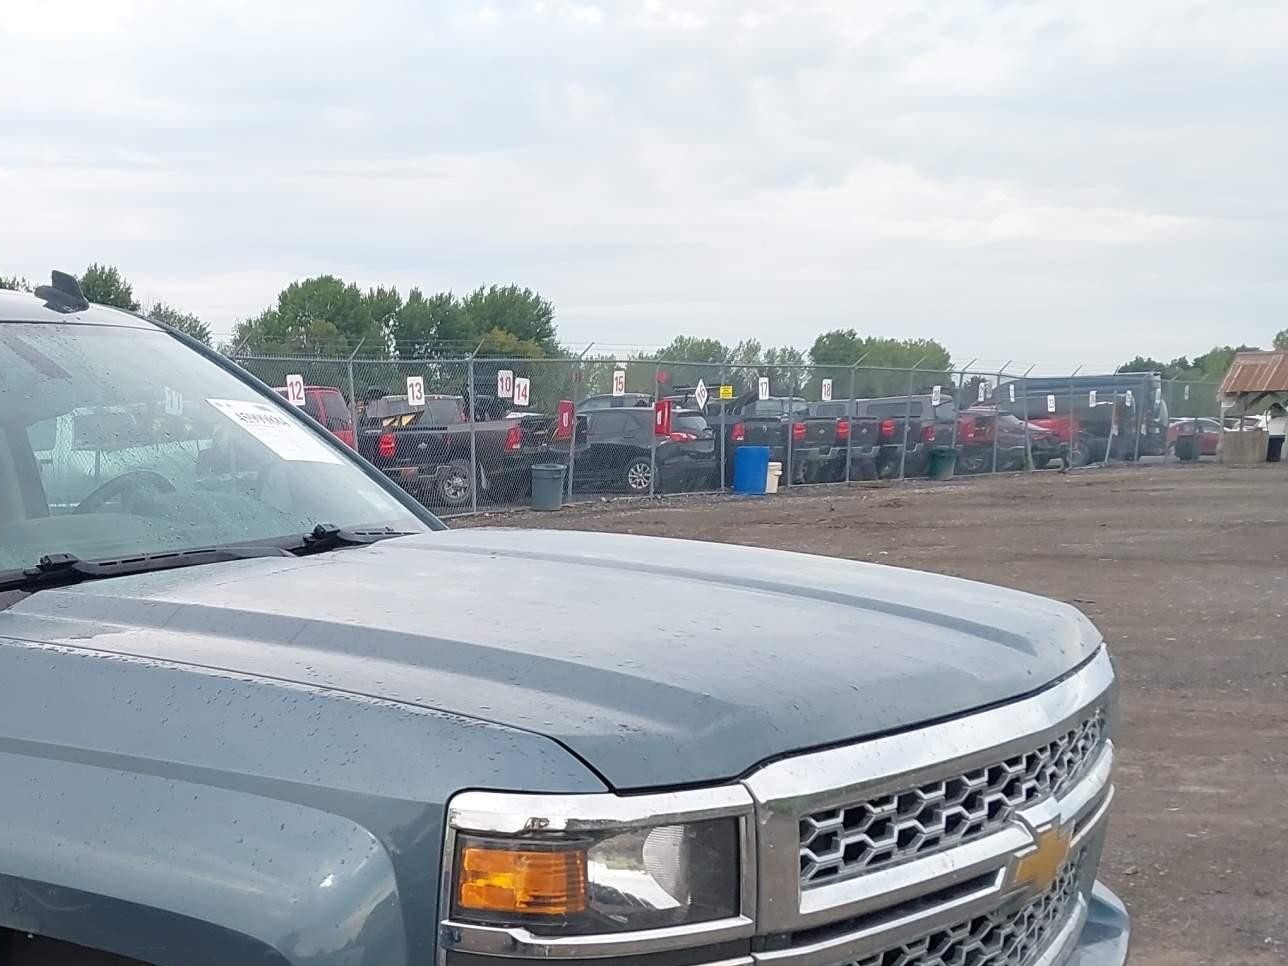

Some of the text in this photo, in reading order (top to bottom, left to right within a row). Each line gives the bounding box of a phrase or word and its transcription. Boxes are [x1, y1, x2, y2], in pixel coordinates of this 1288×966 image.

[288, 380, 303, 401] 12
[408, 382, 423, 401] 13
[515, 383, 528, 401] 14
[614, 375, 624, 392] 15
[760, 382, 768, 397] 17
